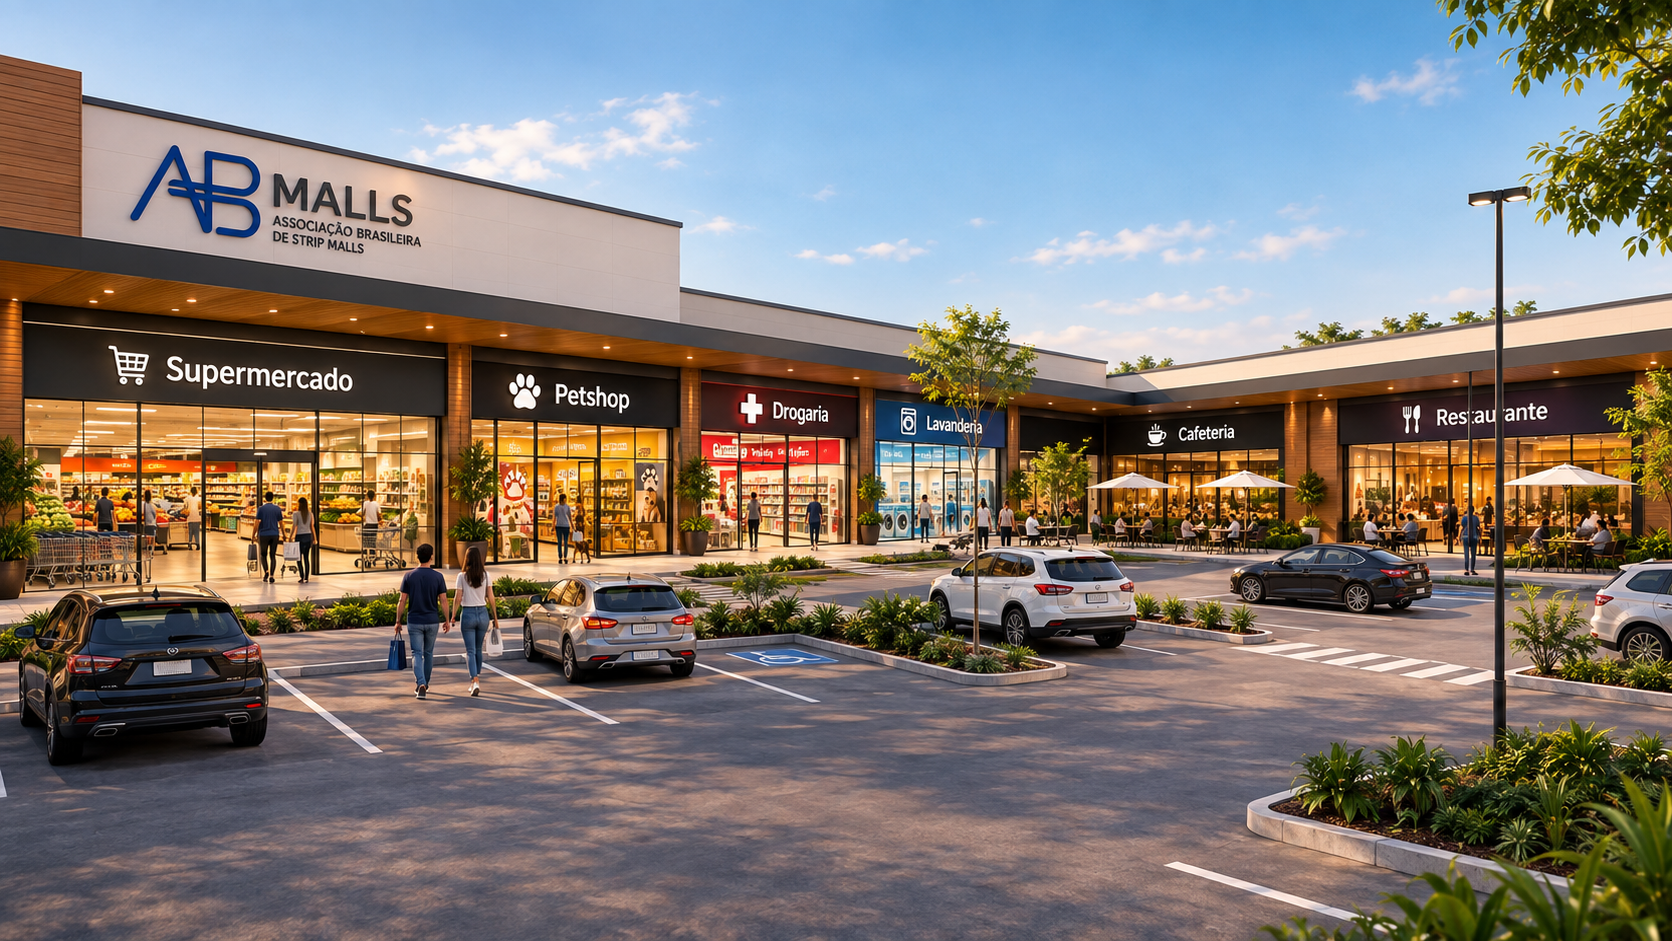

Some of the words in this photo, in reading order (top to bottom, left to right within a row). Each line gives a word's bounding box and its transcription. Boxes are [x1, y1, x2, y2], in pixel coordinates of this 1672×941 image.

[273, 173, 413, 228] MALLS
[272, 215, 354, 238] ASSOCIAÇÃO
[356, 227, 422, 247] BRASILEIRA
[273, 230, 290, 244] DE
[292, 232, 325, 249] STRIP
[327, 236, 365, 254] MALLS
[166, 356, 353, 392] Supermercado
[554, 383, 630, 414] Petshop
[772, 401, 829, 425] Drogaria
[1178, 424, 1235, 442] Cafeteria
